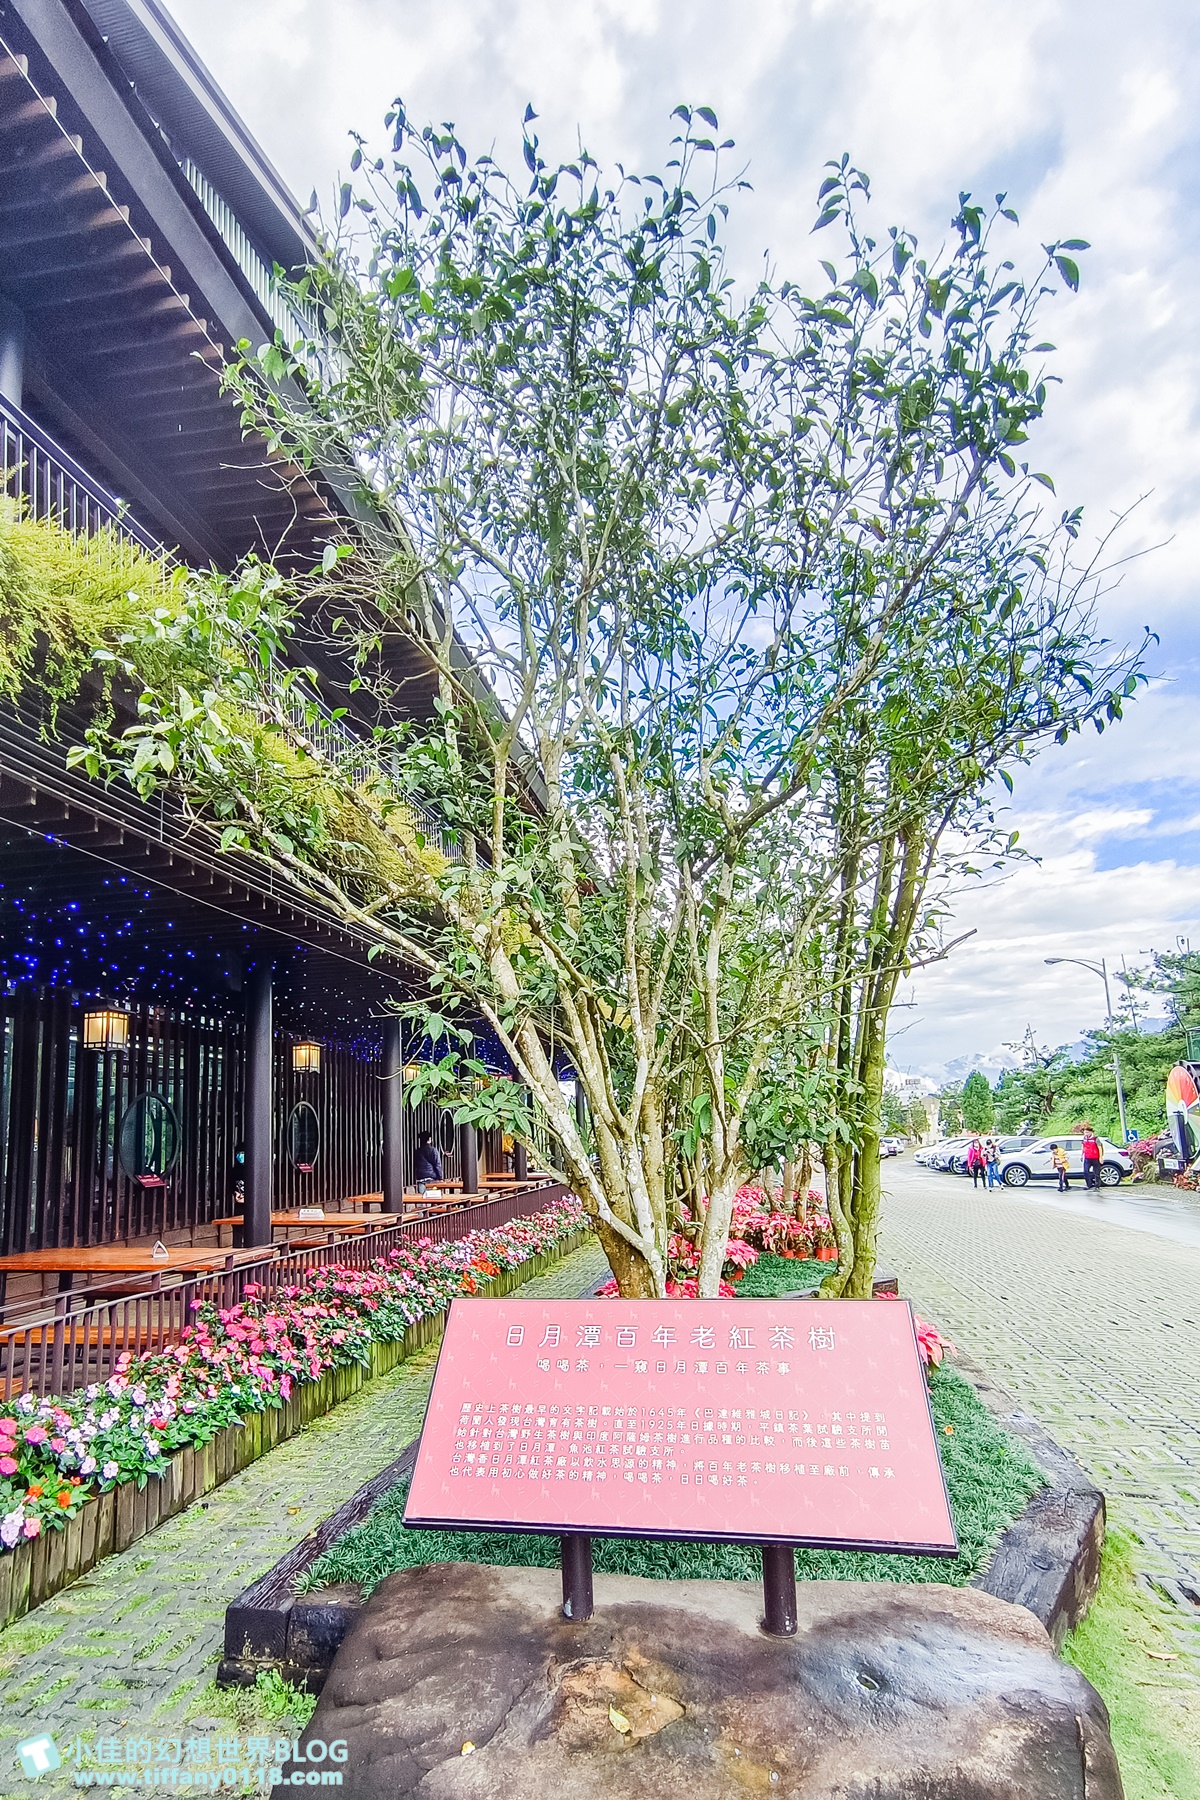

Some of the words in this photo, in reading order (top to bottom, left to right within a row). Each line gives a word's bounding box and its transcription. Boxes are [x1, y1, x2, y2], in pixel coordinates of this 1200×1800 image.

[505, 1324, 837, 1352] 日月潭百年老紅茶樹
